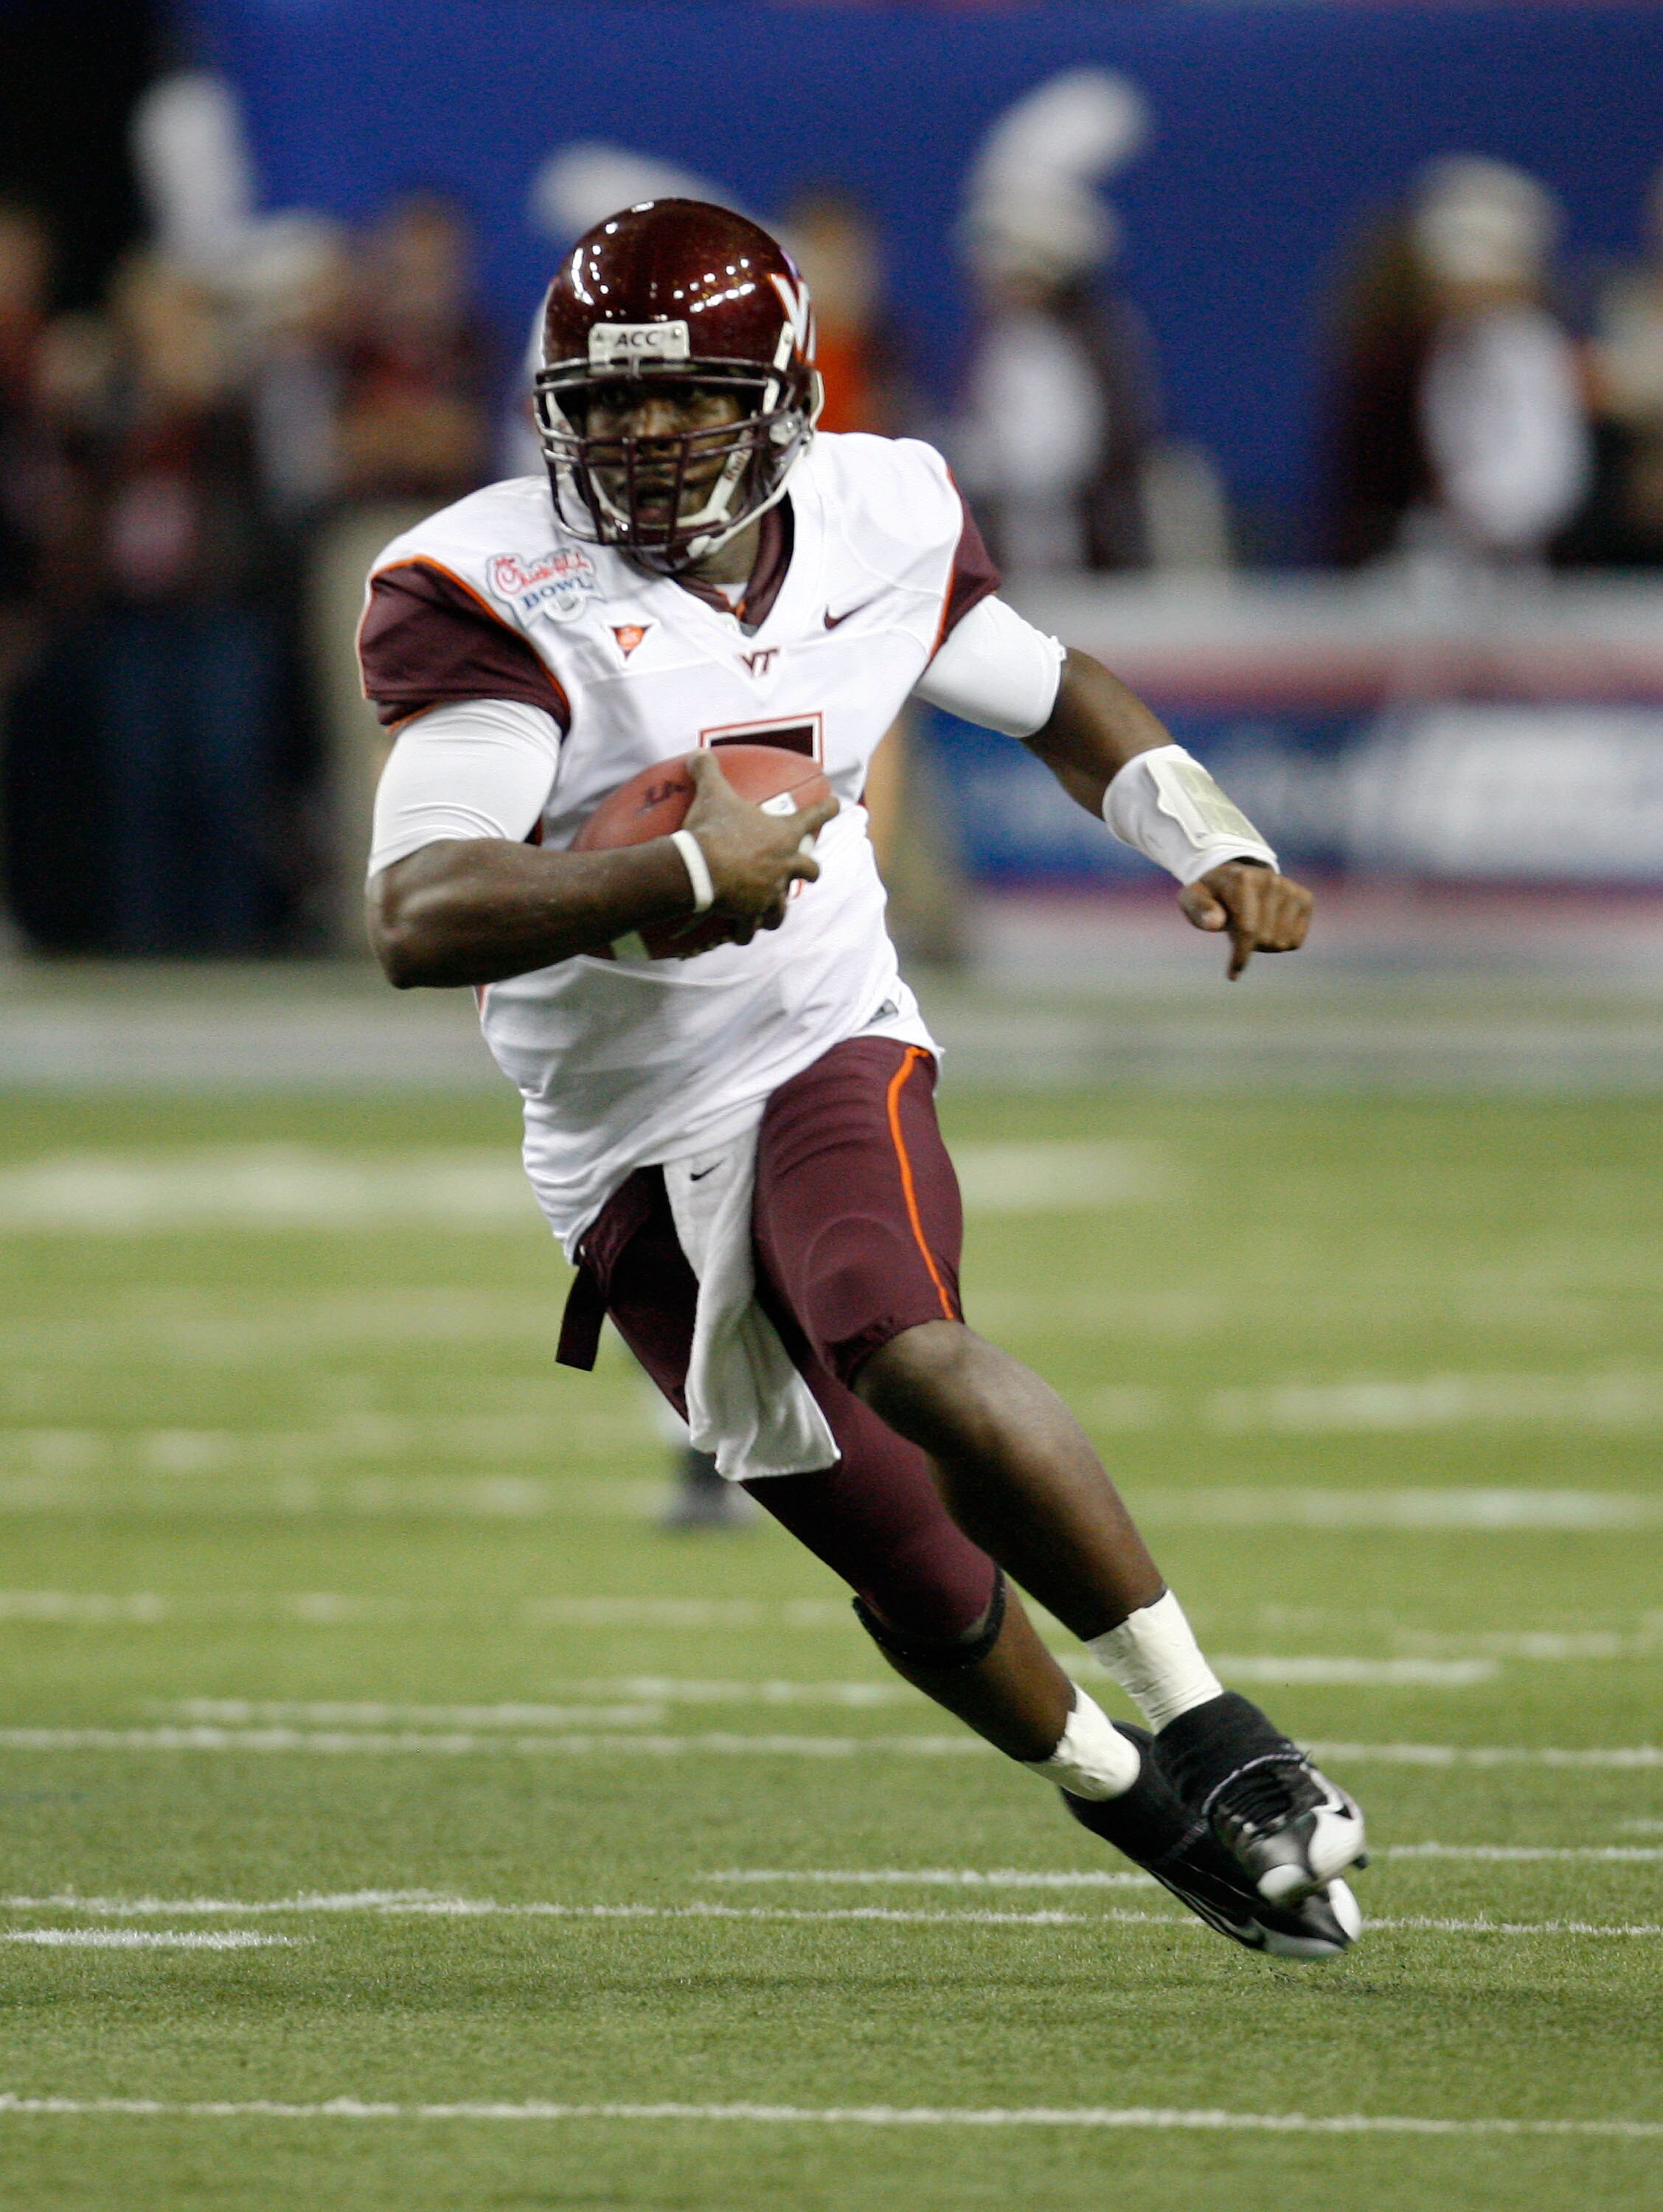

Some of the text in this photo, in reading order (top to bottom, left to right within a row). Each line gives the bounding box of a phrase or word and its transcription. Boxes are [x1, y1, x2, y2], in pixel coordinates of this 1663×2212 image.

[615, 331, 661, 348] ACC
[522, 577, 594, 611] BOWL
[740, 646, 780, 675] VT
